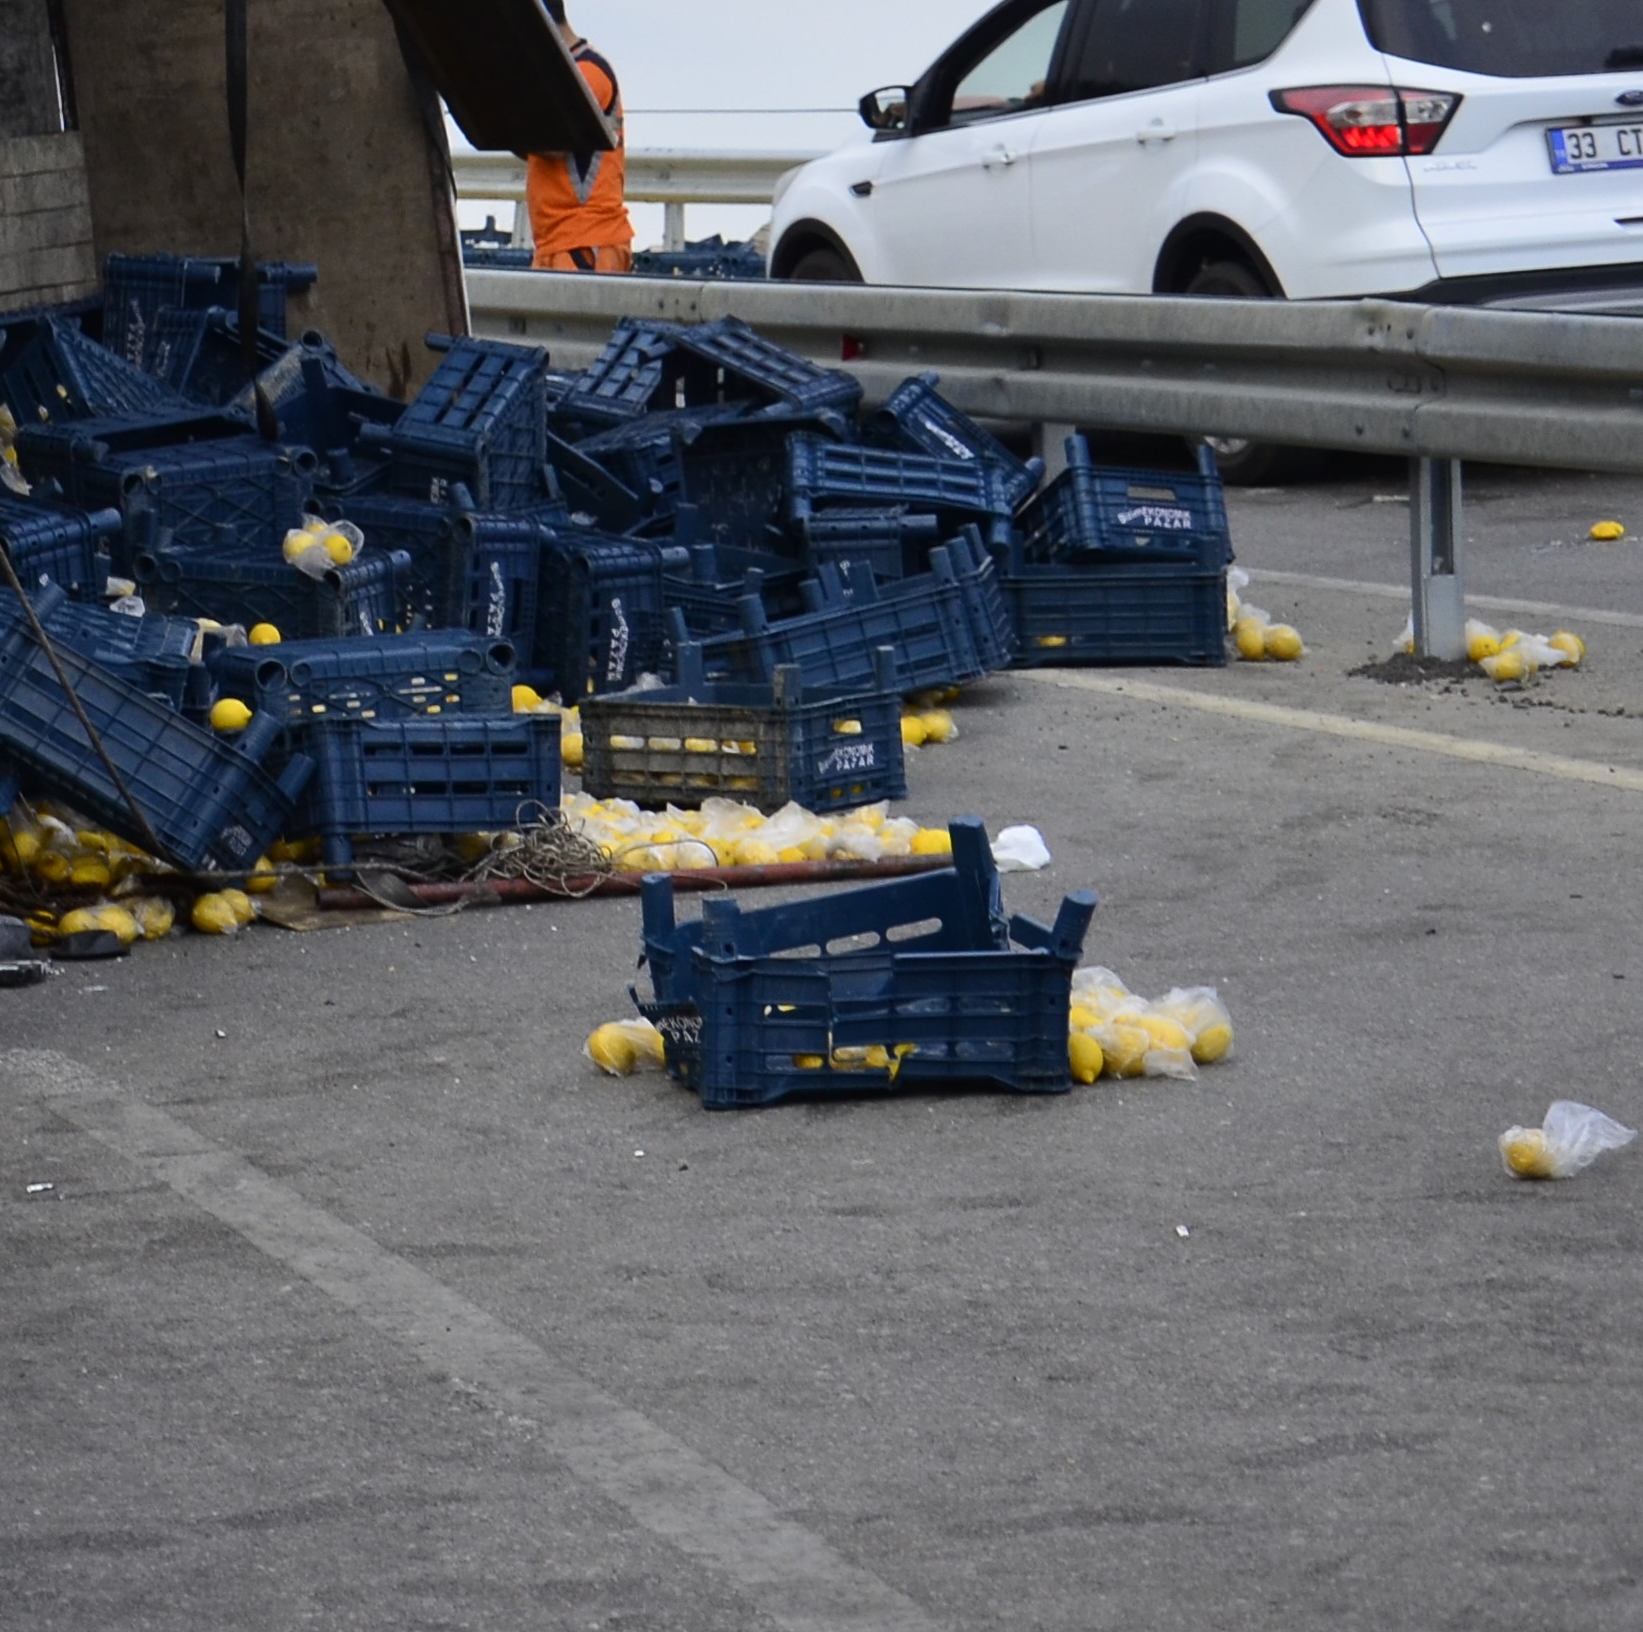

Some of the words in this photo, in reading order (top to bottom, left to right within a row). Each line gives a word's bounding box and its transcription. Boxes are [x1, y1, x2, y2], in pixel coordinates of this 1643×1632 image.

[1568, 132, 1597, 159] 33
[1144, 515, 1192, 529] PAZAR
[671, 1029, 701, 1044] PAZ
